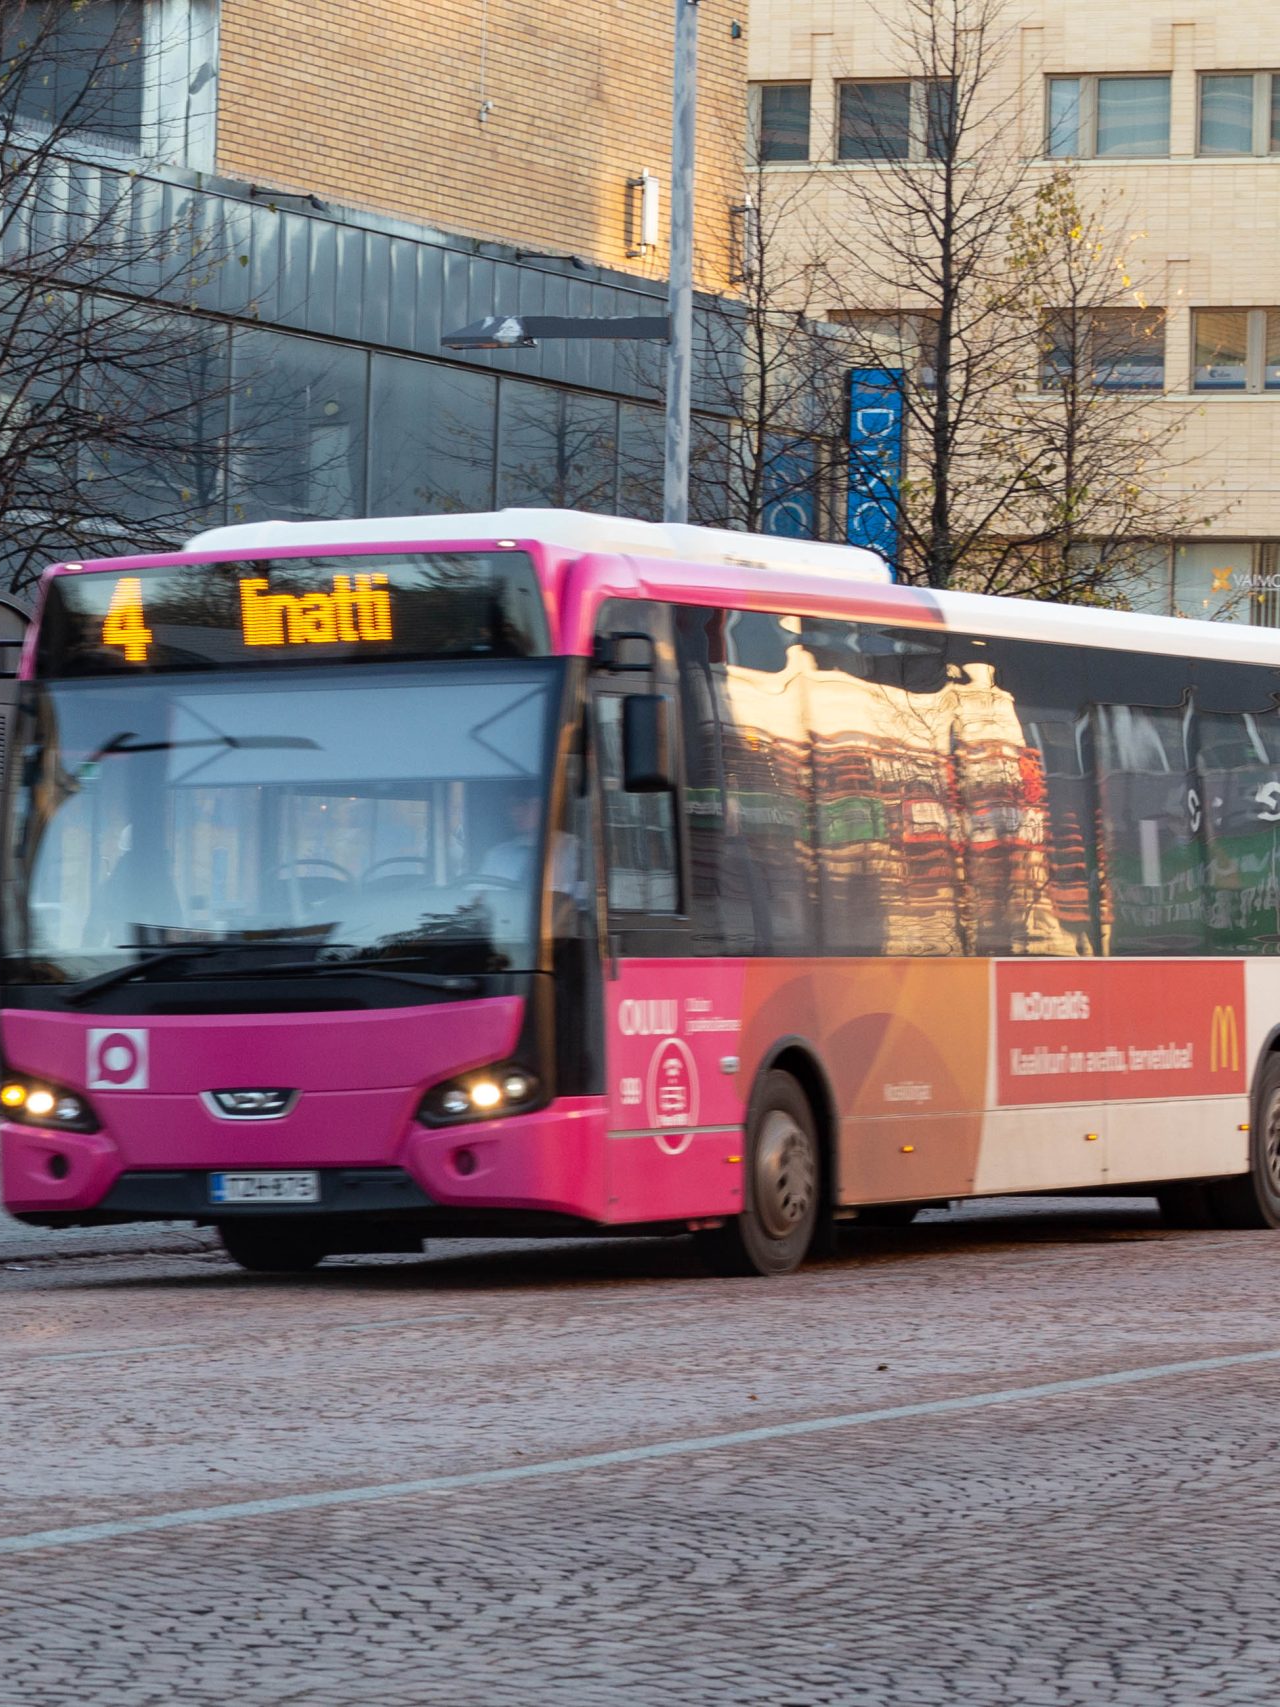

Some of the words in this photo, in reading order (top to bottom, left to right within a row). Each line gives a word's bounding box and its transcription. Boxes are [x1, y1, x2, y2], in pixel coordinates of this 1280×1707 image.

[102, 577, 153, 661] 4
[619, 999, 678, 1035] OULU
[1010, 990, 1090, 1021] McDonald's
